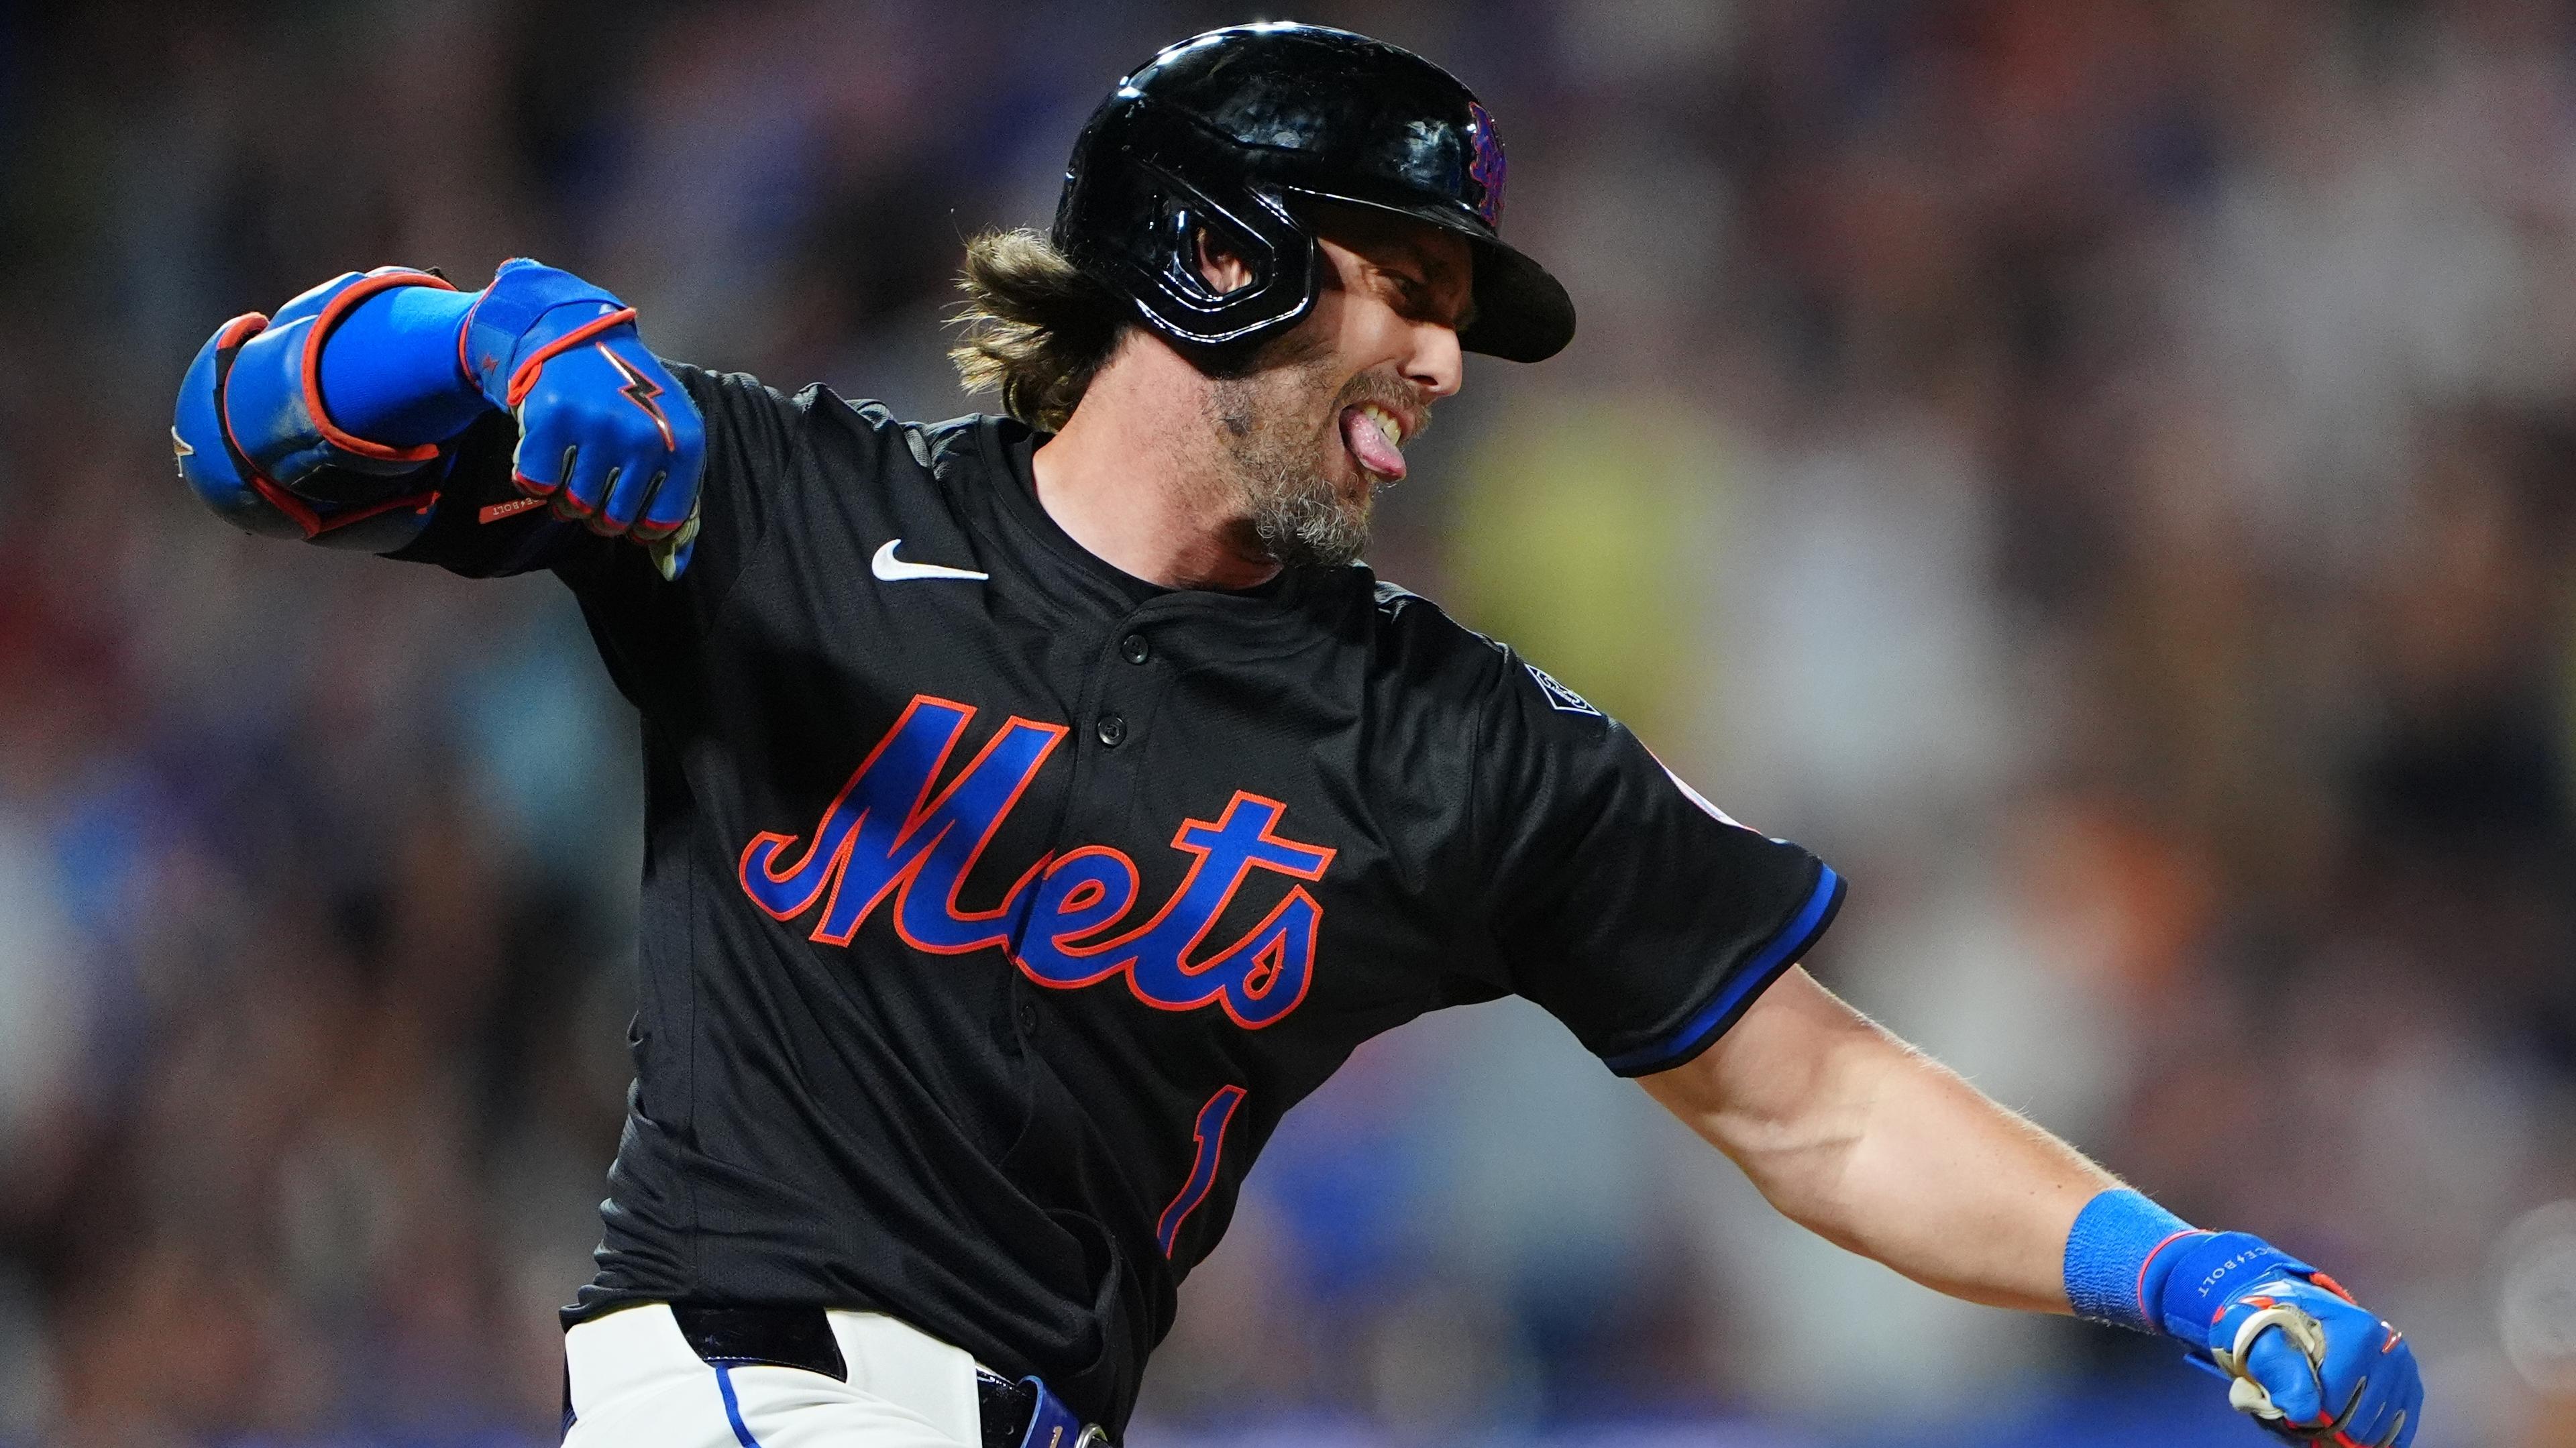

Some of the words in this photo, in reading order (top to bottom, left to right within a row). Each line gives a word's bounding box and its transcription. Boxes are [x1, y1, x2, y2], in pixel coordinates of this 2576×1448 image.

[492, 501, 520, 516] BOLT
[739, 693, 1337, 1030] Mets
[1157, 1084, 1247, 1260] 1
[2198, 1260, 2238, 1298] BOLT
